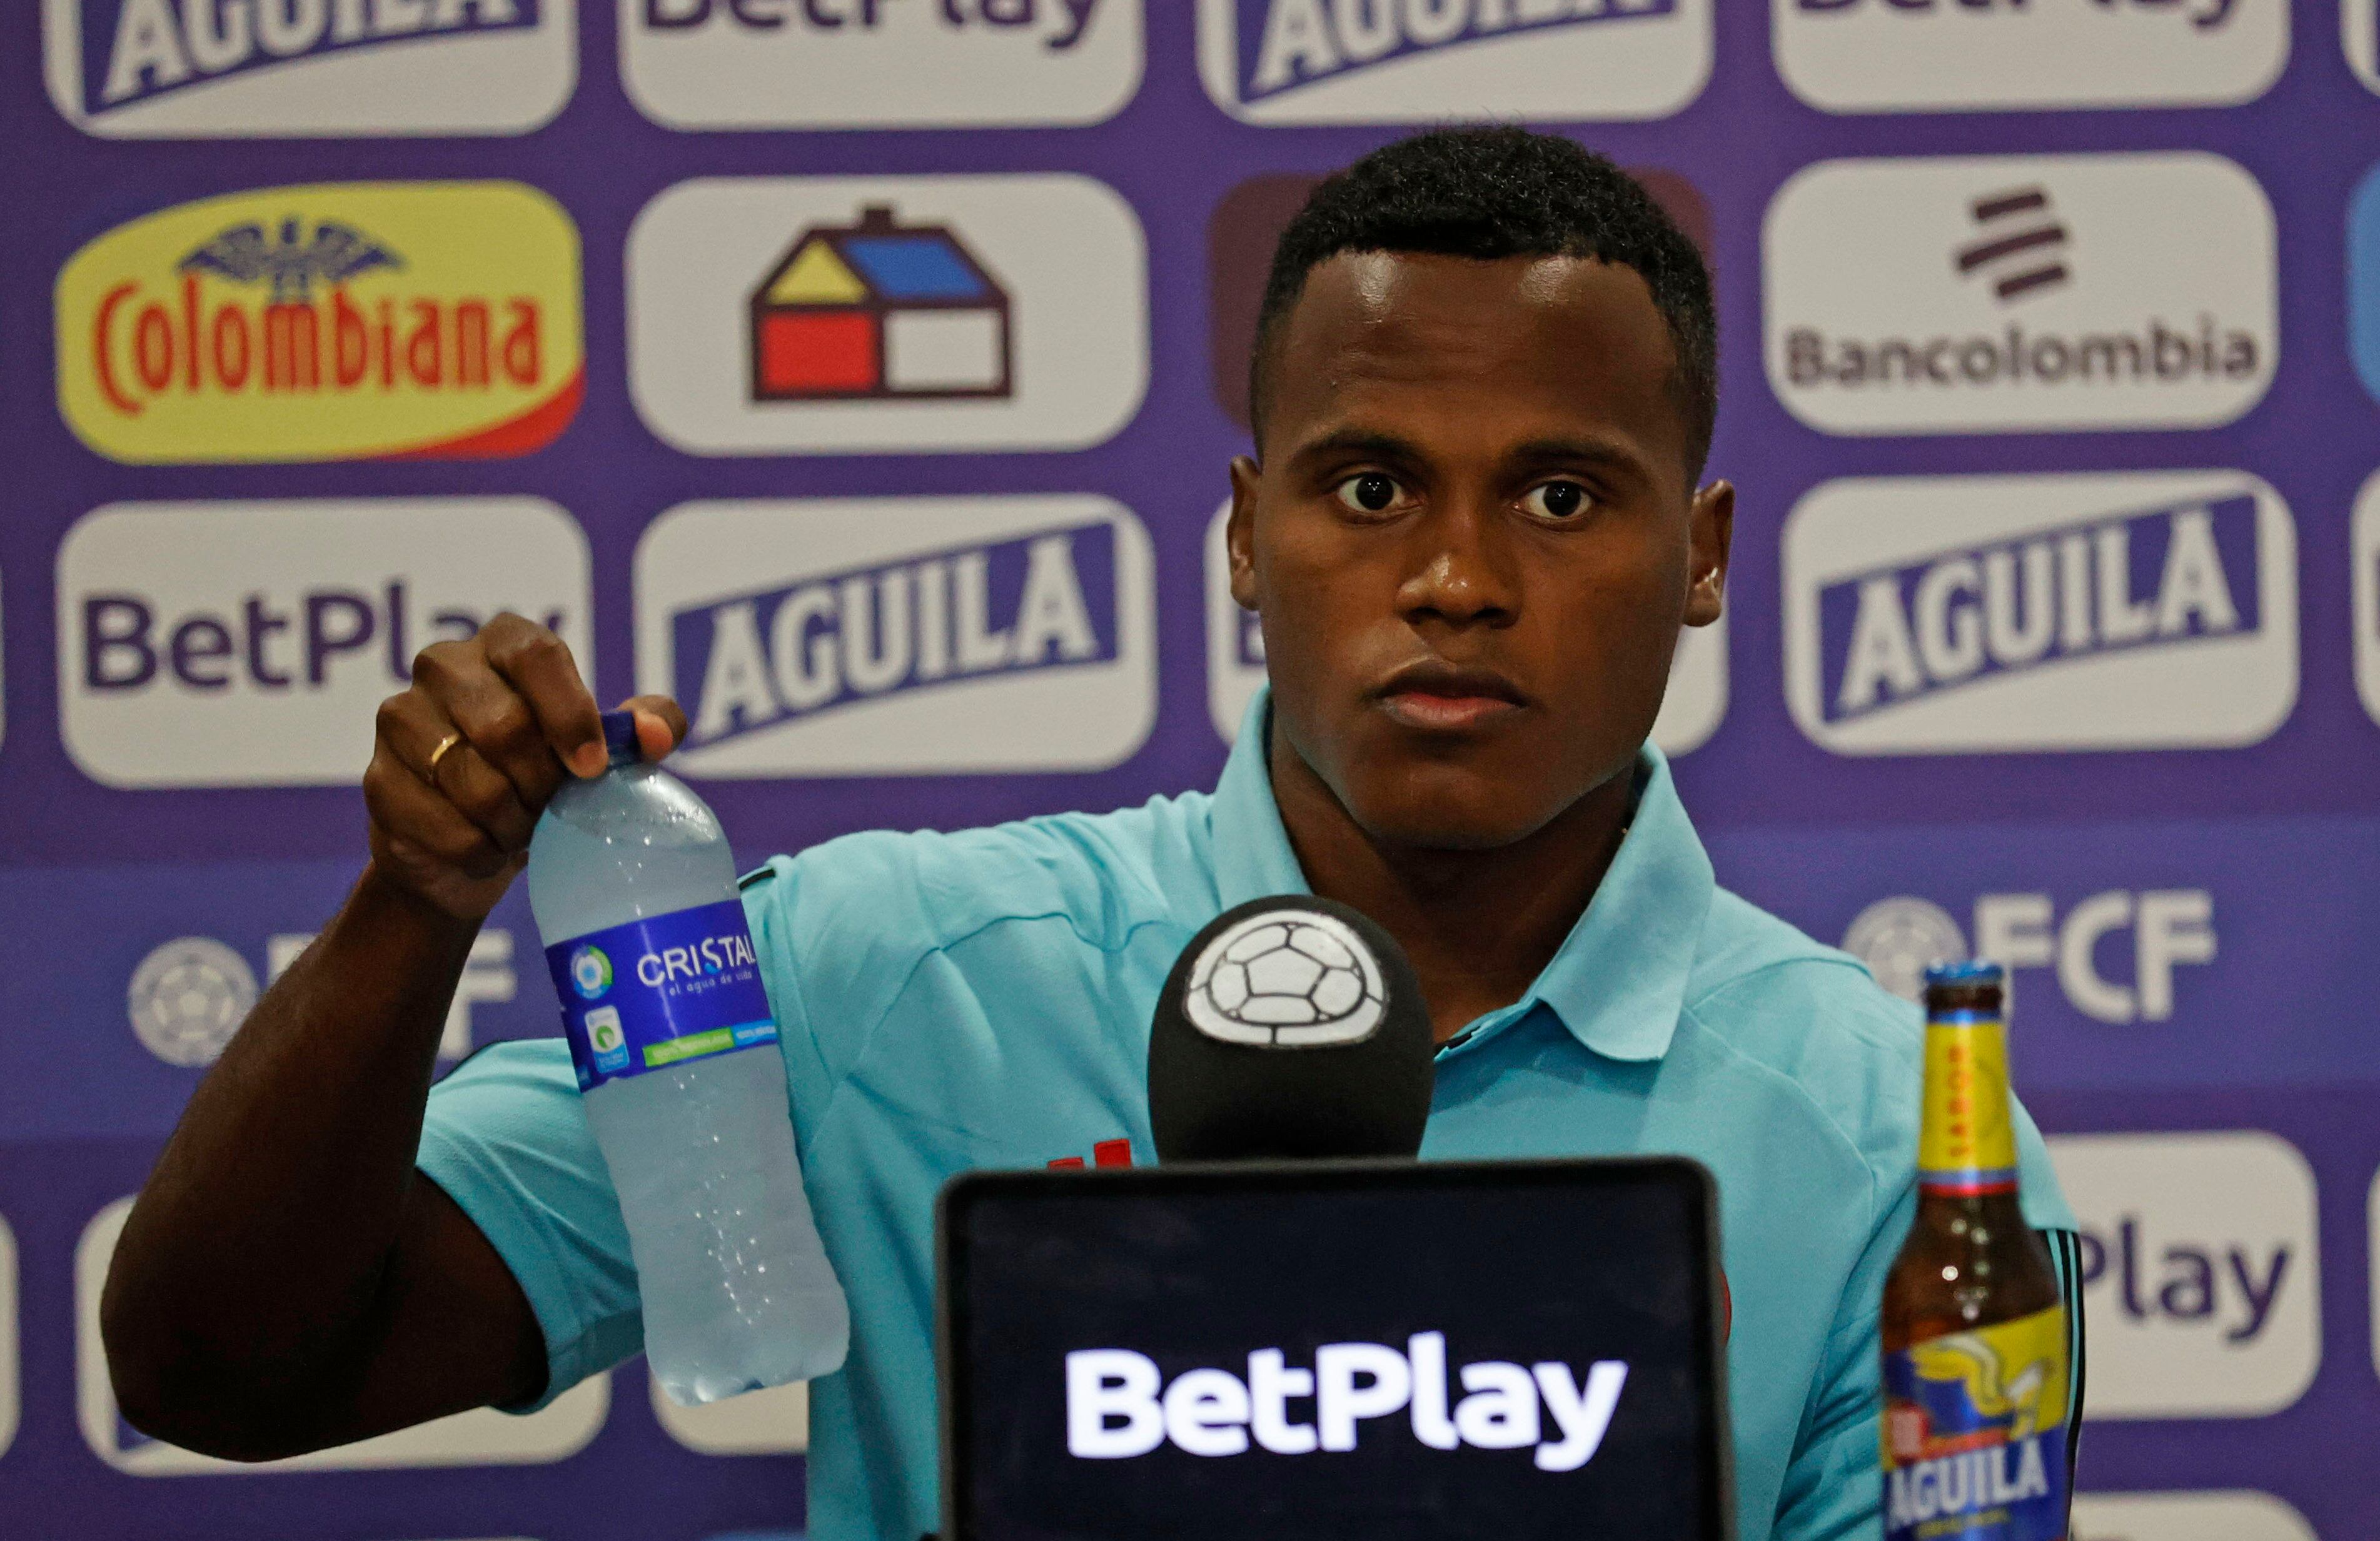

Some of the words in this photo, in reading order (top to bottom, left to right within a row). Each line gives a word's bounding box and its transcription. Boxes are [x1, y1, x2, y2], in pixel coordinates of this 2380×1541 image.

[92, 270, 543, 418] Colombiana
[1783, 313, 2259, 386] Bancolombia
[84, 581, 563, 691] BetPl
[692, 535, 1099, 741] AGUILA
[1837, 506, 2240, 714] AGUILA
[637, 935, 756, 987] CRISTAL
[1975, 890, 2217, 1025] FCF
[1064, 1330, 1628, 1472] BetPlay
[1888, 1438, 2049, 1529] AGUILA
